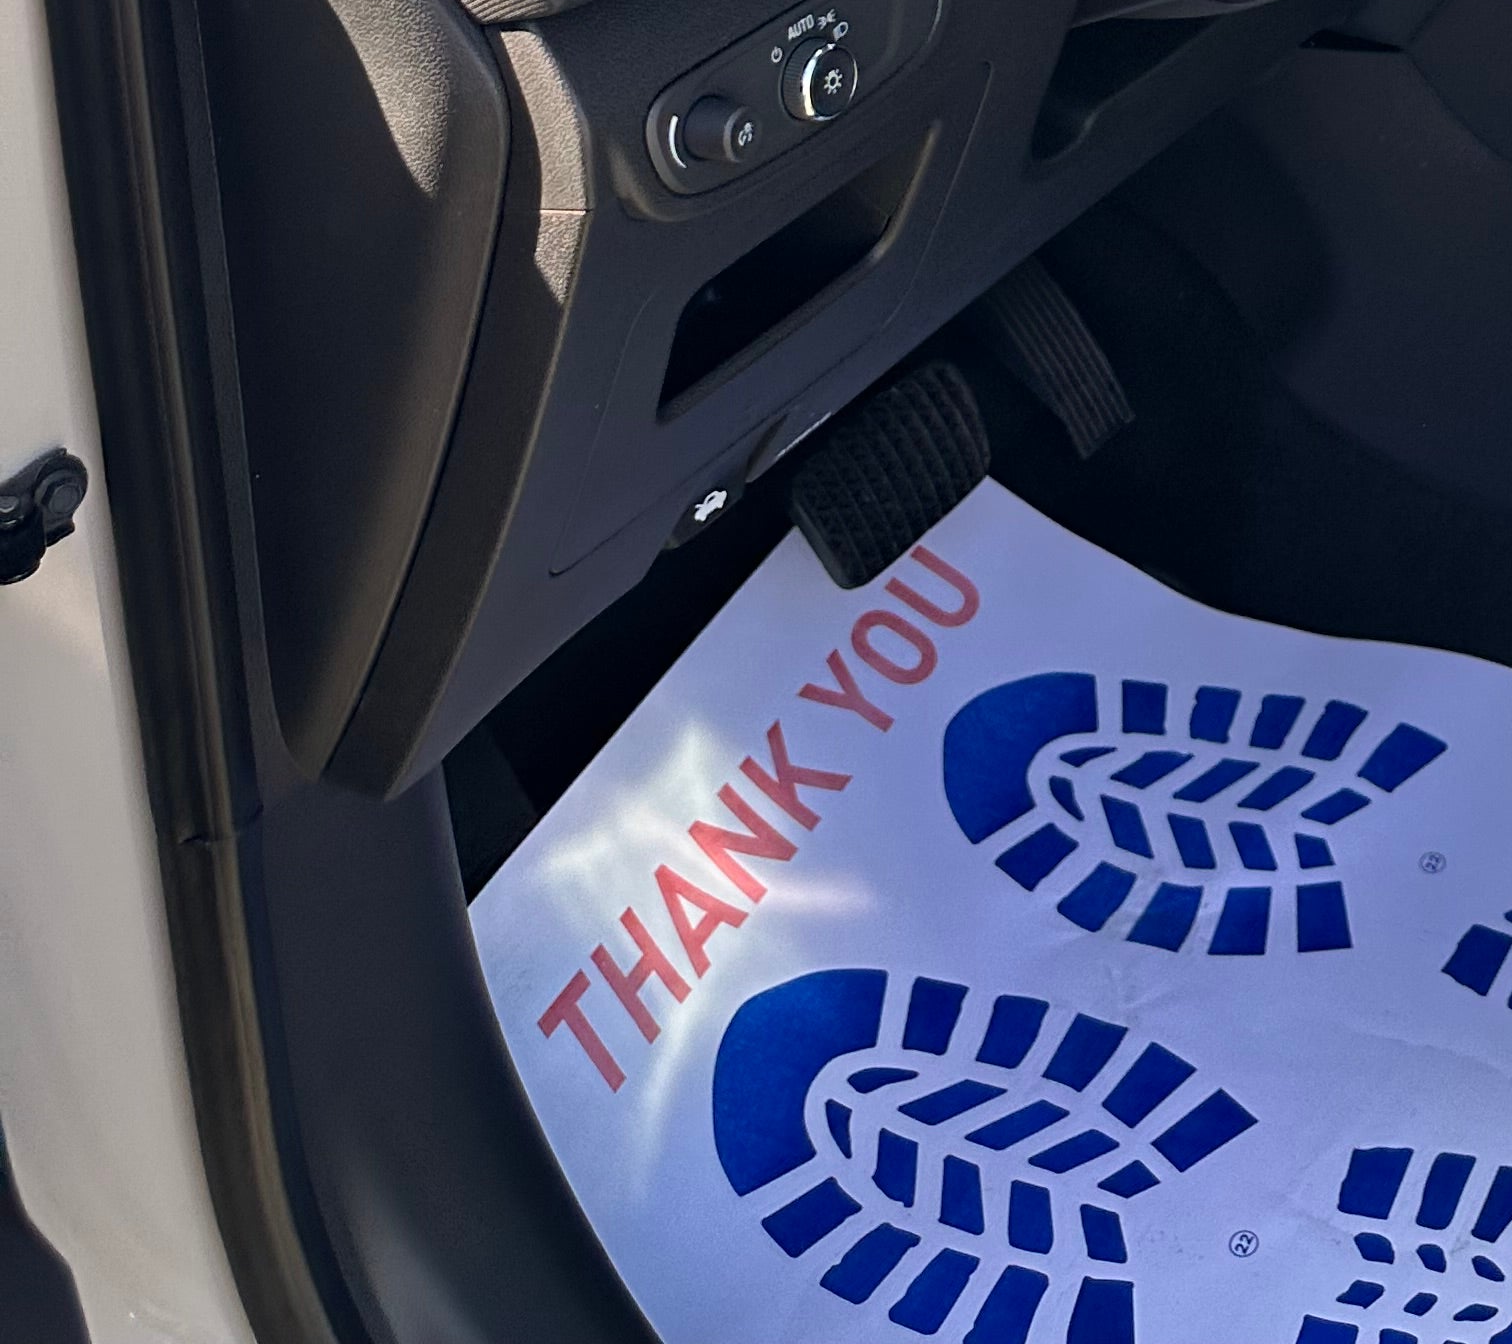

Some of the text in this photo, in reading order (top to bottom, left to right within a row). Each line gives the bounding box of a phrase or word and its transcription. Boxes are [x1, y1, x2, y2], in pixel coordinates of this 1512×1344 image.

[788, 14, 814, 40] AUTO
[537, 545, 980, 1092] THANK YOU
[1234, 1233, 1256, 1254] 22
